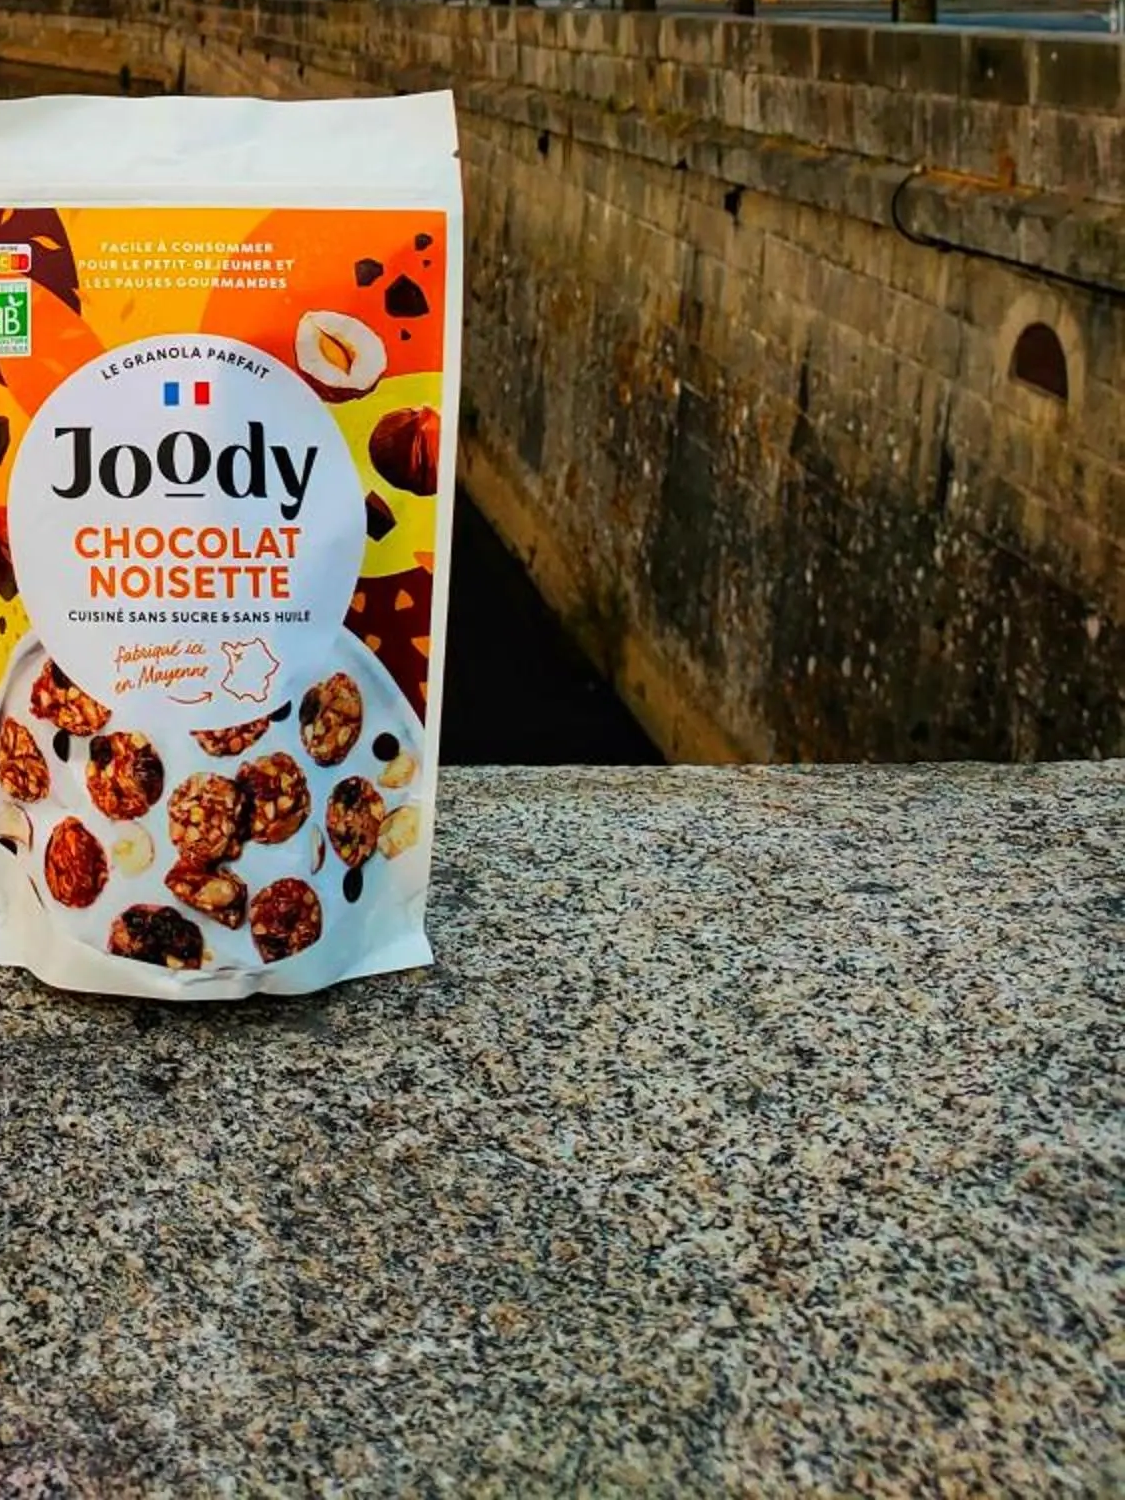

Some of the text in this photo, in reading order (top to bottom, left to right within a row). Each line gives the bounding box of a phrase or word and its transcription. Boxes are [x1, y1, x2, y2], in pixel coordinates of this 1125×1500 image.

[101, 241, 153, 254] FACILE
[171, 241, 274, 254] CONSOMMER
[78, 259, 118, 271] POUR
[122, 259, 141, 271] LE
[277, 259, 295, 271] ET
[85, 276, 288, 289] LES PAUSES GOURMANDES
[100, 347, 271, 380] LE GRANOLA PARFAIT
[75, 527, 301, 558] CHOCOLAT
[90, 566, 290, 599] NOISETTE
[69, 607, 125, 623] CUISINÉ
[128, 611, 167, 623] SANS
[171, 611, 218, 623] SUCRE
[233, 611, 271, 623] SANS
[274, 610, 311, 622] HUILE
[138, 665, 209, 688] Mayenne
